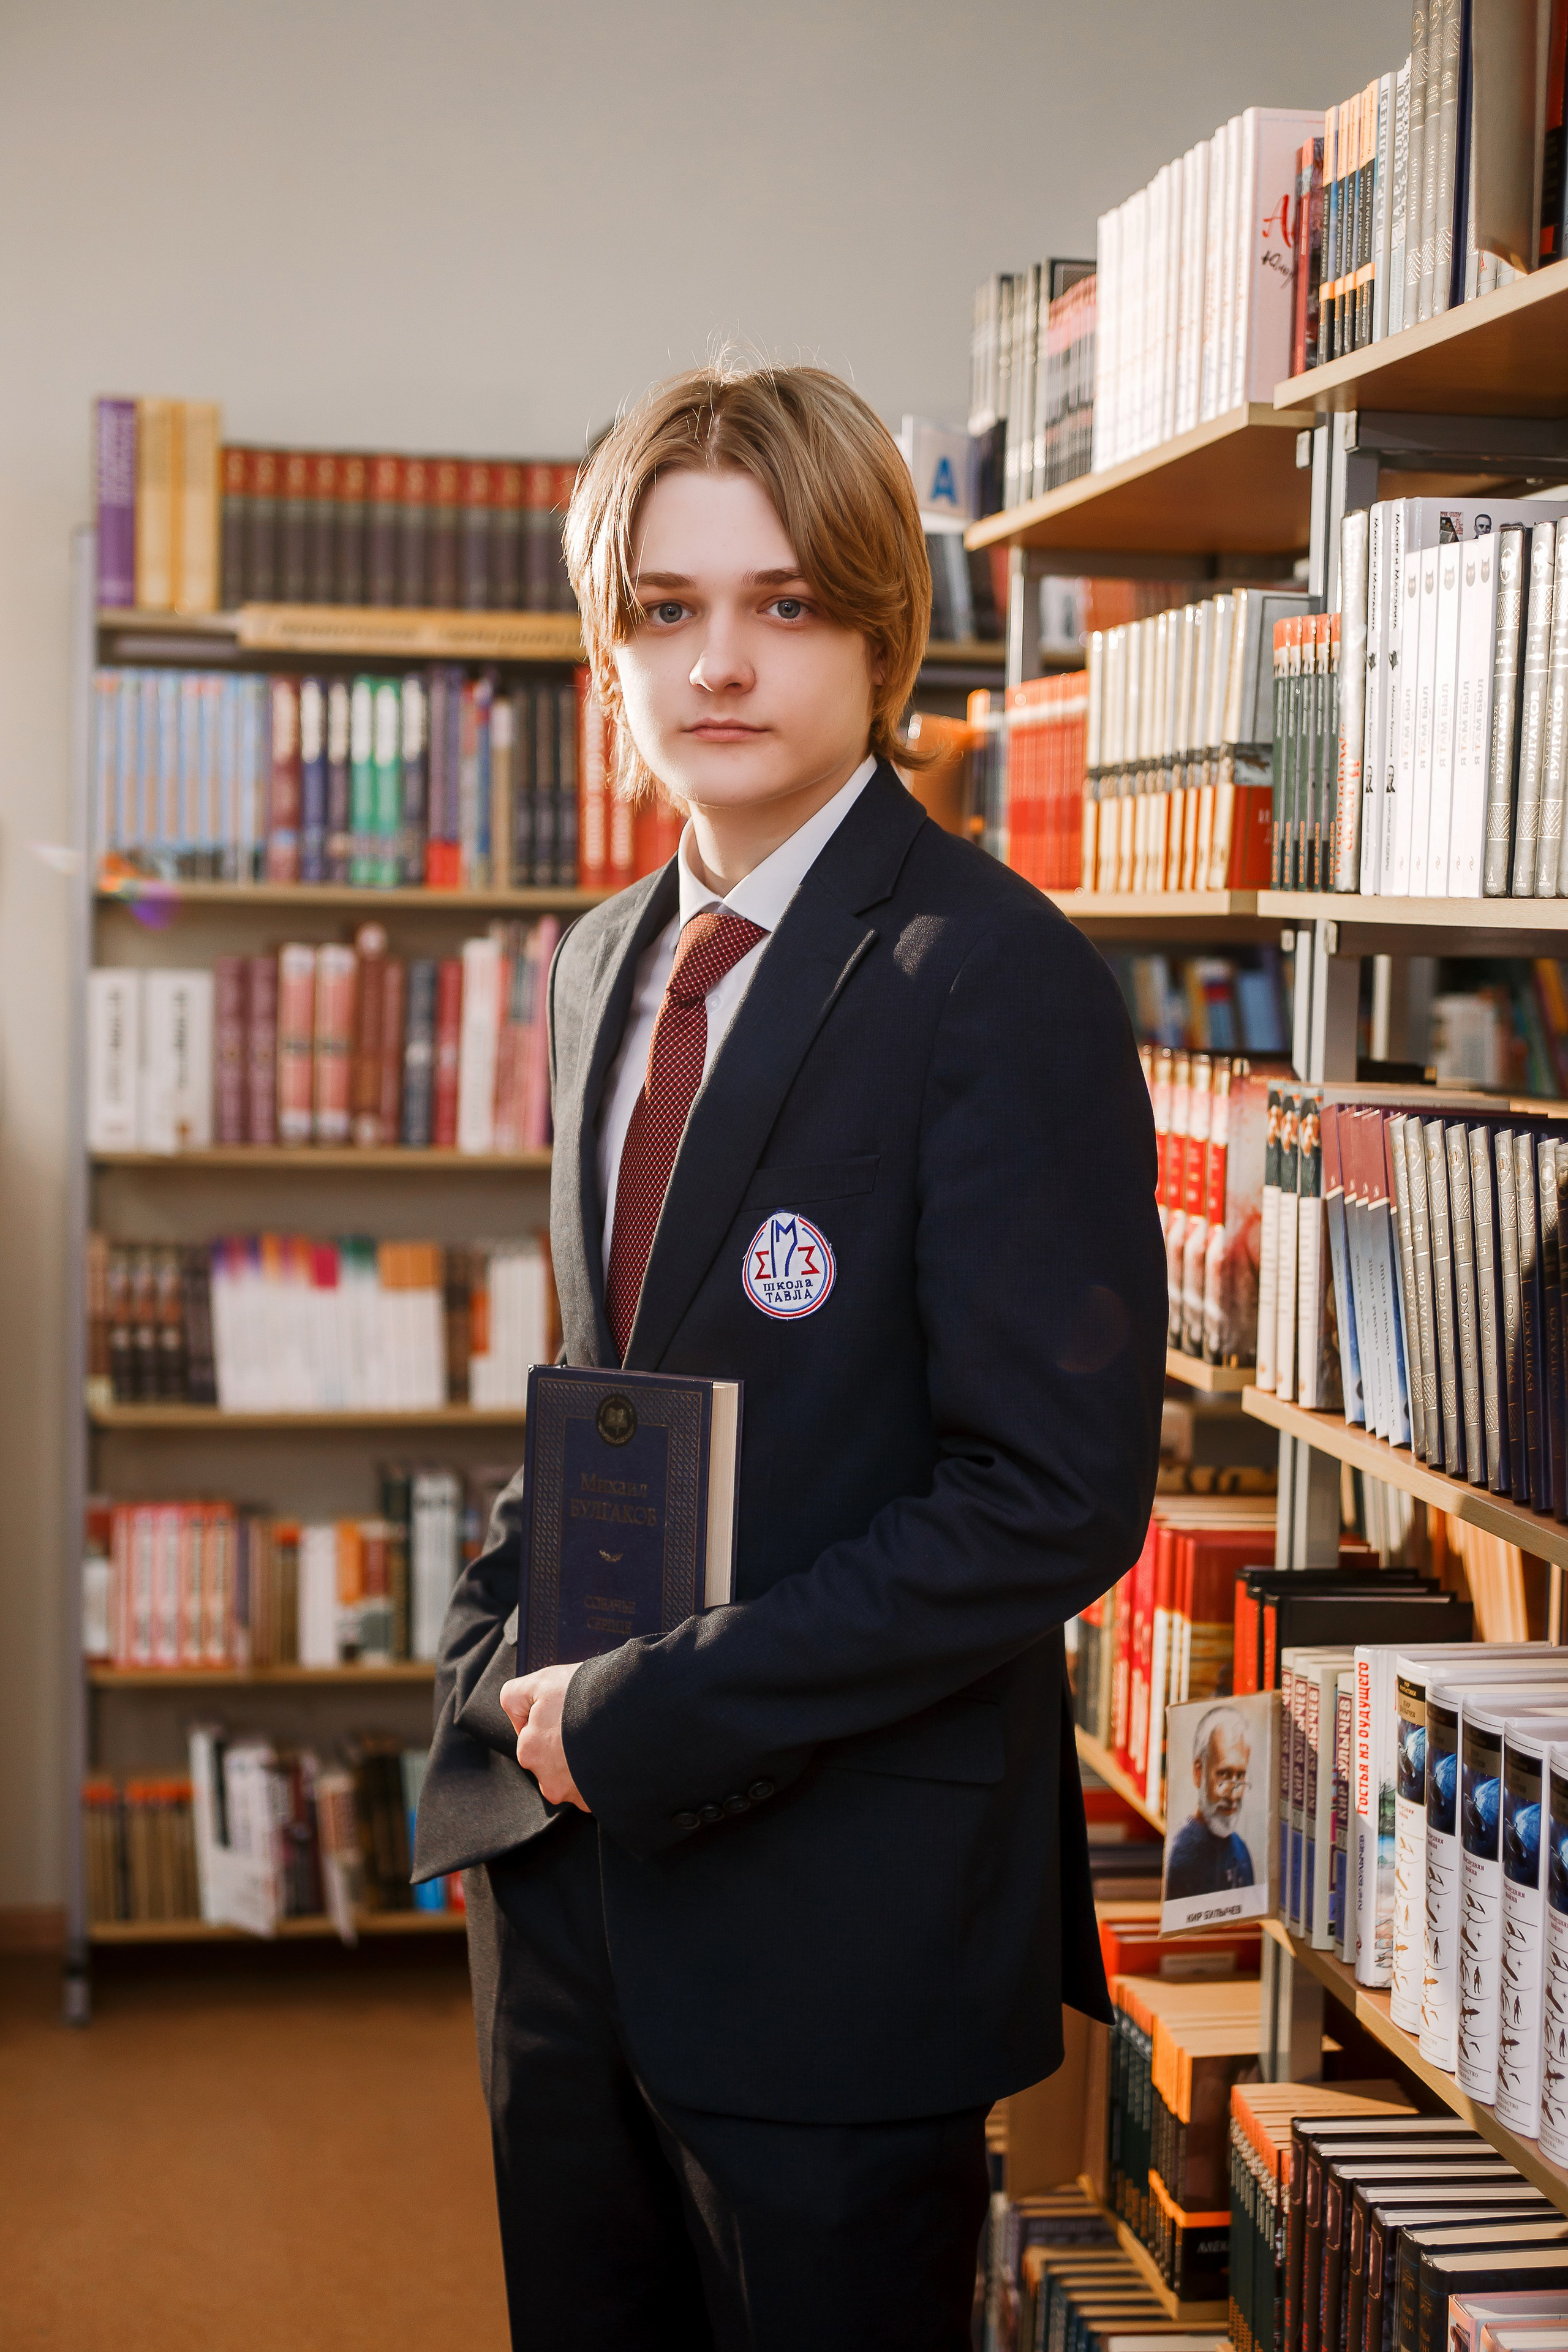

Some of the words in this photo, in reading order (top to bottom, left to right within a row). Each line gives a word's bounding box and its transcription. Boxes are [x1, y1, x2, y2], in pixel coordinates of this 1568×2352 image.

[1378, 98, 1388, 177] БЕЛЯЕВ
[1393, 94, 1404, 173] БЕЛЯЕВ
[1403, 762, 1408, 771] Я
[1420, 760, 1426, 769] Я
[1439, 758, 1446, 768] Я
[1461, 757, 1467, 766] Я
[1474, 756, 1480, 765] Я
[1495, 693, 1508, 785] БУЛГАКОВ
[1527, 690, 1540, 783] БУЛГАКОВ
[1550, 684, 1564, 782] БУЛГАКОВ
[766, 1288, 813, 1303] ТАВЛА
[1417, 1270, 1430, 1358] БУЛГАКОВ
[1438, 1276, 1449, 1364] БУЛГАКОВ
[1460, 1282, 1471, 1370] БУЛГАКОВ
[1480, 1287, 1493, 1377] БУЛГАКОВ
[1506, 1293, 1516, 1385] БУЛГАКОВ
[1523, 1300, 1535, 1392] БУЛГАКОВ
[1549, 1306, 1559, 1399] БУЛГАКОВ
[570, 1498, 658, 1526] БУЛГАКОВ
[579, 1472, 649, 1499] Михаил
[1293, 1681, 1306, 1763] БУЛЫЧЕВ
[1338, 1698, 1352, 1781] БУЛЫЧЕВ
[1359, 1743, 1368, 1760] из
[1292, 1766, 1303, 1800] КИР
[1336, 1784, 1348, 1820] КИР
[1356, 1764, 1368, 1816] Гостья
[1186, 1912, 1202, 1924] КИР
[1204, 1904, 1242, 1921] БУЛЫЧЕВ
